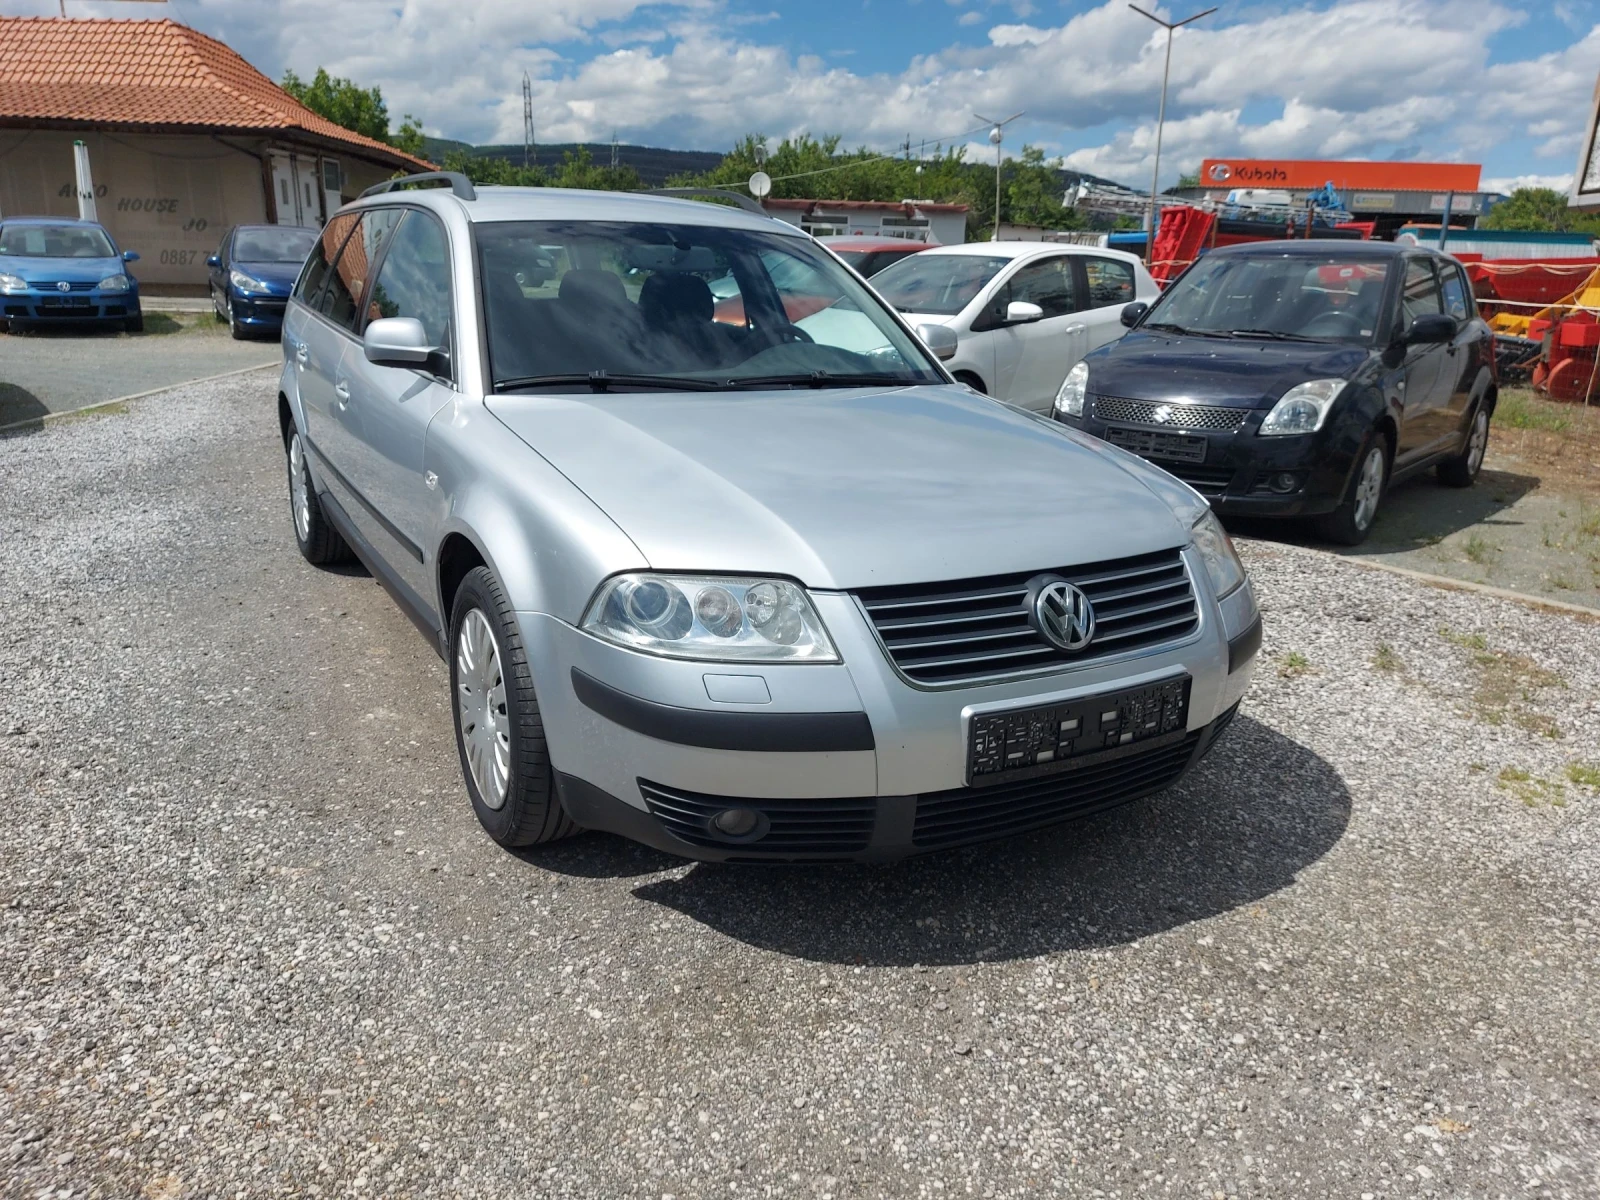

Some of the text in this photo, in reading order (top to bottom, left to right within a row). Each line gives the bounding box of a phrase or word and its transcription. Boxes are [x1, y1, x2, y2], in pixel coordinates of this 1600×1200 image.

[1235, 167, 1287, 180] Kubota
[59, 184, 207, 232] AO HOUSE JO
[160, 250, 197, 264] 0887
